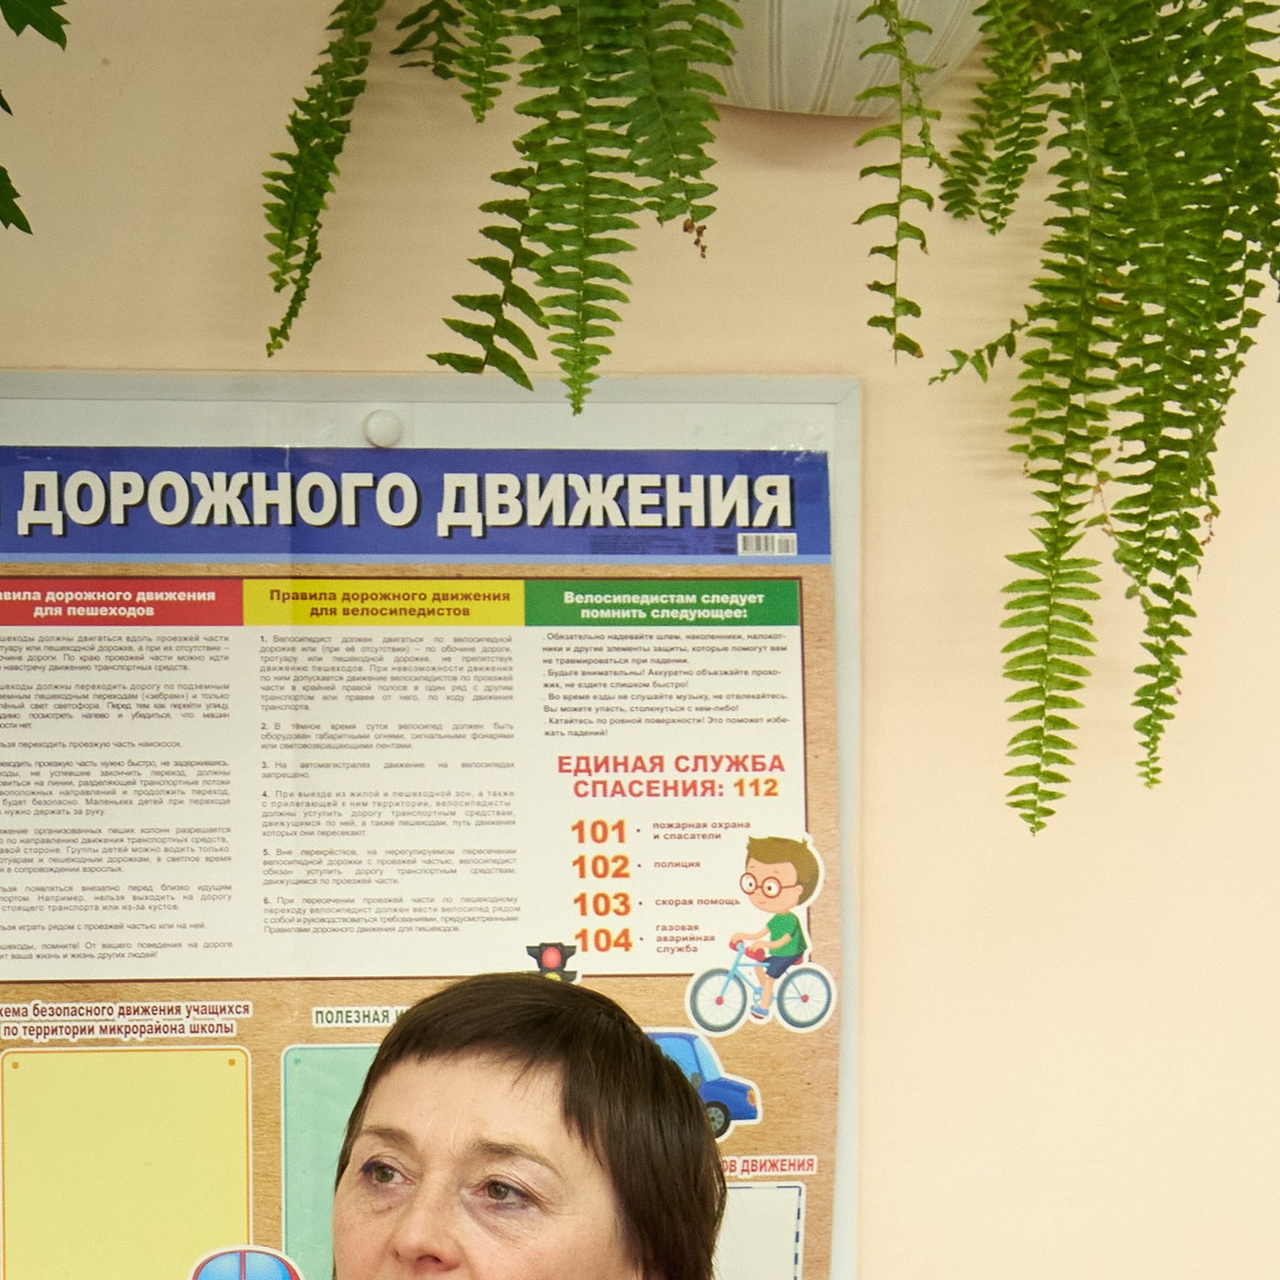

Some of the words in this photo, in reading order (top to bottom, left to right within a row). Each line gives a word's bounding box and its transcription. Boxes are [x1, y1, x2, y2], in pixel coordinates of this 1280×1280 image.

[17, 470, 417, 536] ДОРОЖНОГО
[436, 473, 794, 538] ДВИЖЕНИЯ
[45, 591, 132, 603] дорожного
[136, 591, 215, 602] движения
[270, 589, 336, 603] Правила
[341, 592, 427, 603] дорожного
[431, 592, 510, 602] движения
[564, 591, 696, 605] Велосипедистам
[700, 594, 764, 606] следует
[33, 606, 62, 617] для
[66, 606, 154, 618] пешеходов
[309, 607, 337, 617] для
[342, 607, 470, 618] велосипедистов
[580, 608, 646, 618] помнить
[650, 608, 747, 621] следующее:
[68, 741, 110, 749] проезжую
[558, 755, 664, 776] ЕДИНАЯ
[674, 754, 784, 772] СЛУЖБА
[573, 779, 723, 797] СПАСЕНИЯ:
[734, 778, 777, 796] 112
[572, 820, 624, 843] 101
[652, 822, 707, 830] пожарная
[710, 822, 750, 830] охрана
[572, 855, 629, 878] 102
[574, 892, 630, 916] 103
[654, 899, 693, 907] скорая
[696, 898, 740, 906] помощь
[573, 928, 632, 952] 104
[656, 935, 715, 943] аварийная
[656, 944, 698, 954] служба
[32, 1003, 114, 1018] безопасного
[117, 1003, 182, 1019] движения
[185, 1003, 250, 1018] учащихся
[315, 1010, 389, 1023] ПОЛЕЗНАЯ
[3, 1024, 19, 1037] по
[22, 1023, 95, 1039] территории
[99, 1021, 185, 1039] микрорайона
[189, 1022, 234, 1036] школы
[740, 1158, 814, 1174] ДВИЖЕНИЯ
